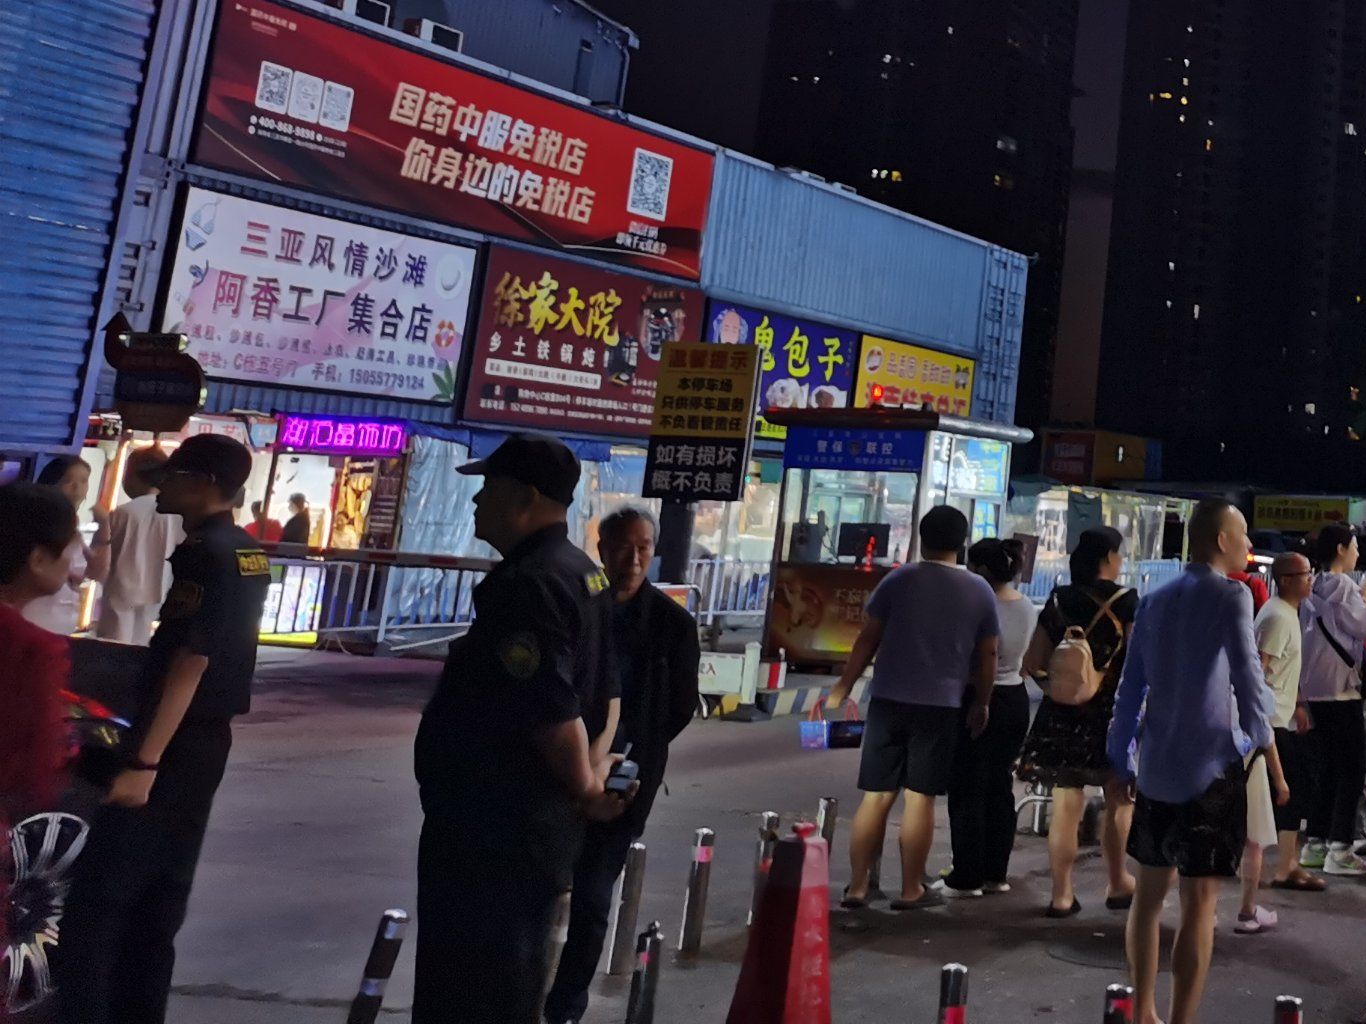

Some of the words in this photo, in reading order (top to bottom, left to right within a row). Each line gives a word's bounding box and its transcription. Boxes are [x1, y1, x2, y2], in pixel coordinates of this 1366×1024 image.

[389, 81, 588, 176] 国药中服免税店
[401, 137, 597, 224] 你身边的免税店
[240, 221, 428, 289] 三亚风情沙滩
[212, 270, 433, 344] 阿香工厂集合店
[493, 271, 622, 347] 徐家大院
[651, 470, 733, 493] 概不负责
[655, 444, 738, 468] 如有损坏
